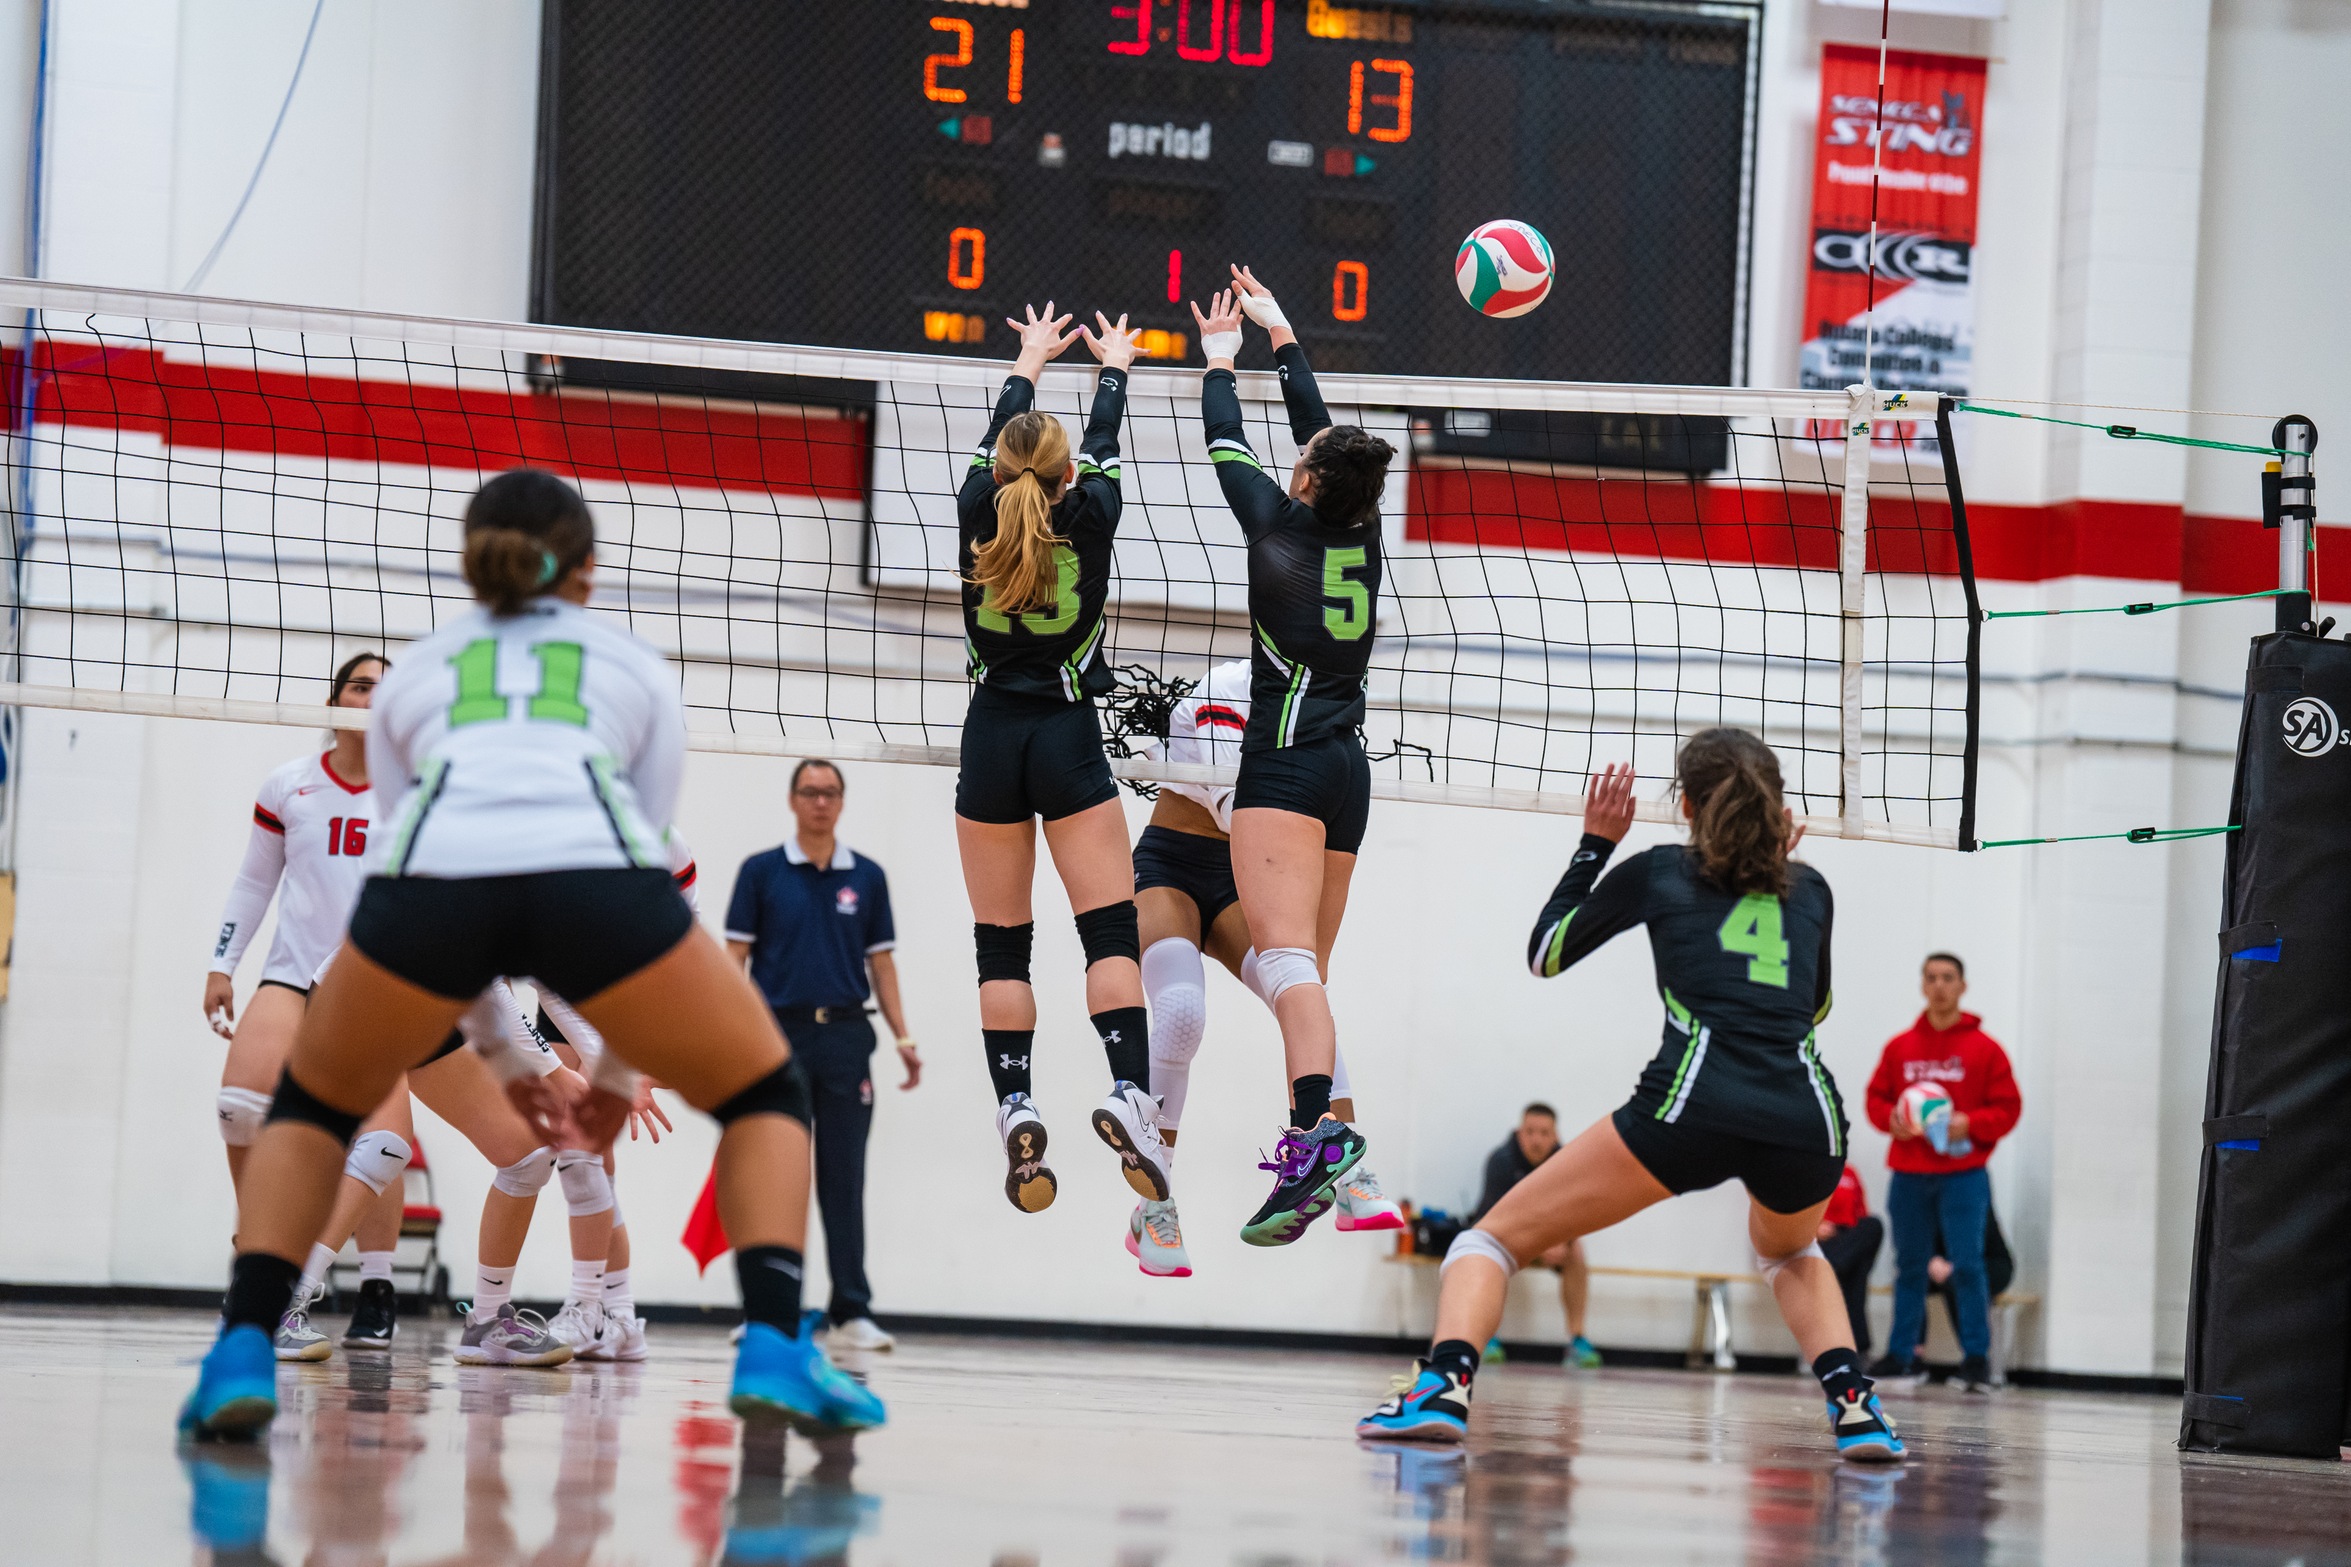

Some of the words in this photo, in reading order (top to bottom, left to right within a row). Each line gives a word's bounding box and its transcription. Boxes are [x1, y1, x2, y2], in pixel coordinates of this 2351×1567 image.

[924, 17, 1025, 104] 21
[1108, 0, 1275, 66] 3:00
[1347, 59, 1414, 142] 13
[1108, 121, 1212, 160] period
[948, 227, 985, 289] 0
[1167, 250, 1182, 302] 1
[1333, 260, 1368, 321] 0
[1322, 545, 1370, 641] 5
[446, 637, 589, 730] 11
[328, 816, 369, 857] 16
[1716, 892, 1789, 990] 4
